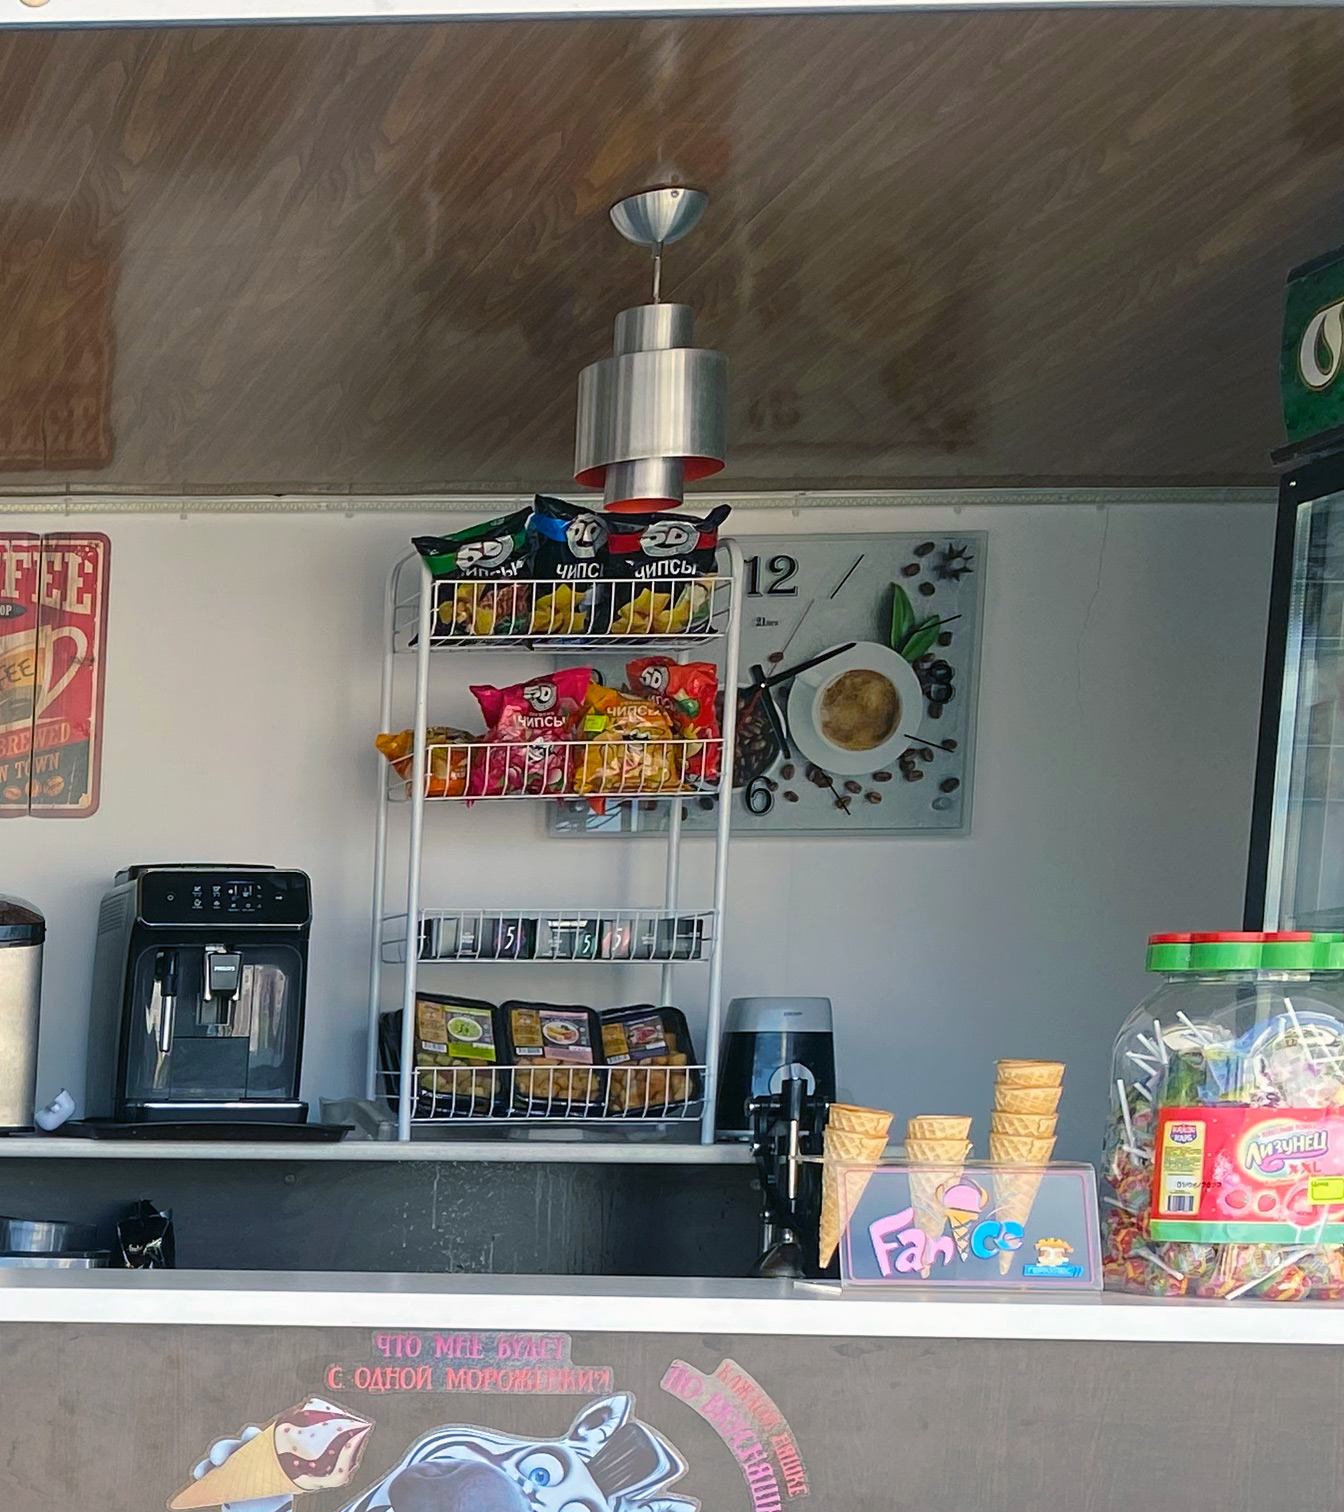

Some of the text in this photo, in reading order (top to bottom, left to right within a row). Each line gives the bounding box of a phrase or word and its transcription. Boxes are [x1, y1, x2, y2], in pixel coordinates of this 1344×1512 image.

[744, 555, 799, 598] 12
[15, 752, 60, 780] TOWN
[745, 776, 775, 816] 6
[504, 927, 516, 950] 5
[582, 934, 591, 954] 5
[1246, 1131, 1328, 1169] ЛИЗУНЕЦ
[1288, 1161, 1321, 1175] XXL
[868, 1206, 955, 1277] Fan
[375, 1334, 422, 1358] ЧТО
[434, 1334, 484, 1359] МНЕ
[327, 1366, 343, 1389] С
[354, 1365, 433, 1392] ОДНОЙ
[663, 1362, 704, 1399] ПО
